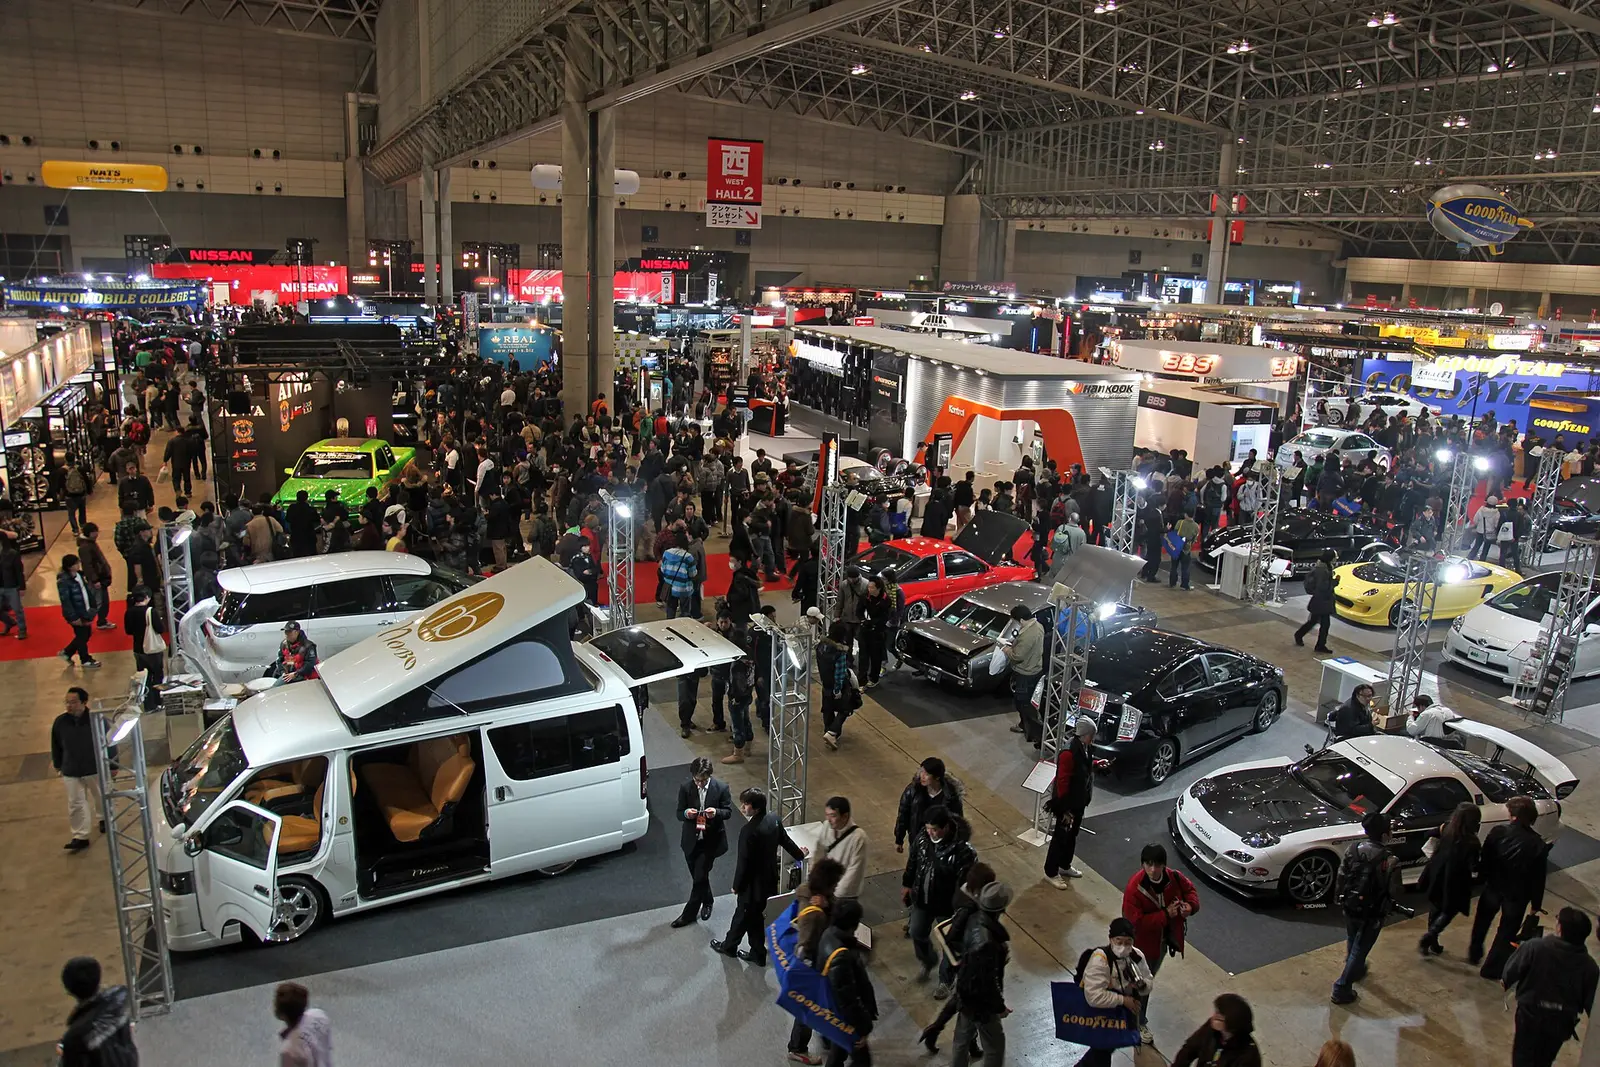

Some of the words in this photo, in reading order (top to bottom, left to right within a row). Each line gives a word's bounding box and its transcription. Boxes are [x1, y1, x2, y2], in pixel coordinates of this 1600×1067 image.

[721, 145, 750, 177] 西
[89, 169, 121, 177] NATS
[725, 178, 744, 186] WEST
[715, 189, 743, 200] HALL
[743, 186, 754, 200] 2
[711, 205, 743, 213] アンケート
[1465, 202, 1517, 227] GOODYEAR
[711, 212, 743, 220] プレゼント
[189, 250, 253, 262] NISSAN
[640, 259, 689, 270] NISSAN
[280, 282, 339, 293] NISSAN
[521, 286, 563, 295] NISSA
[10, 289, 41, 302] NIHON
[43, 291, 135, 305] AUTOMOBILE
[139, 290, 189, 304] COLLEGE
[503, 335, 536, 344] REAL
[1163, 354, 1215, 374] BBS
[1271, 360, 1296, 377] BBS
[1435, 354, 1565, 378] GOODYEAR
[1147, 396, 1166, 407] BBS
[1533, 418, 1590, 434] GOODYEAR
[788, 990, 855, 1034] GOODYEAR
[1062, 1013, 1127, 1030] GOODYEAR
